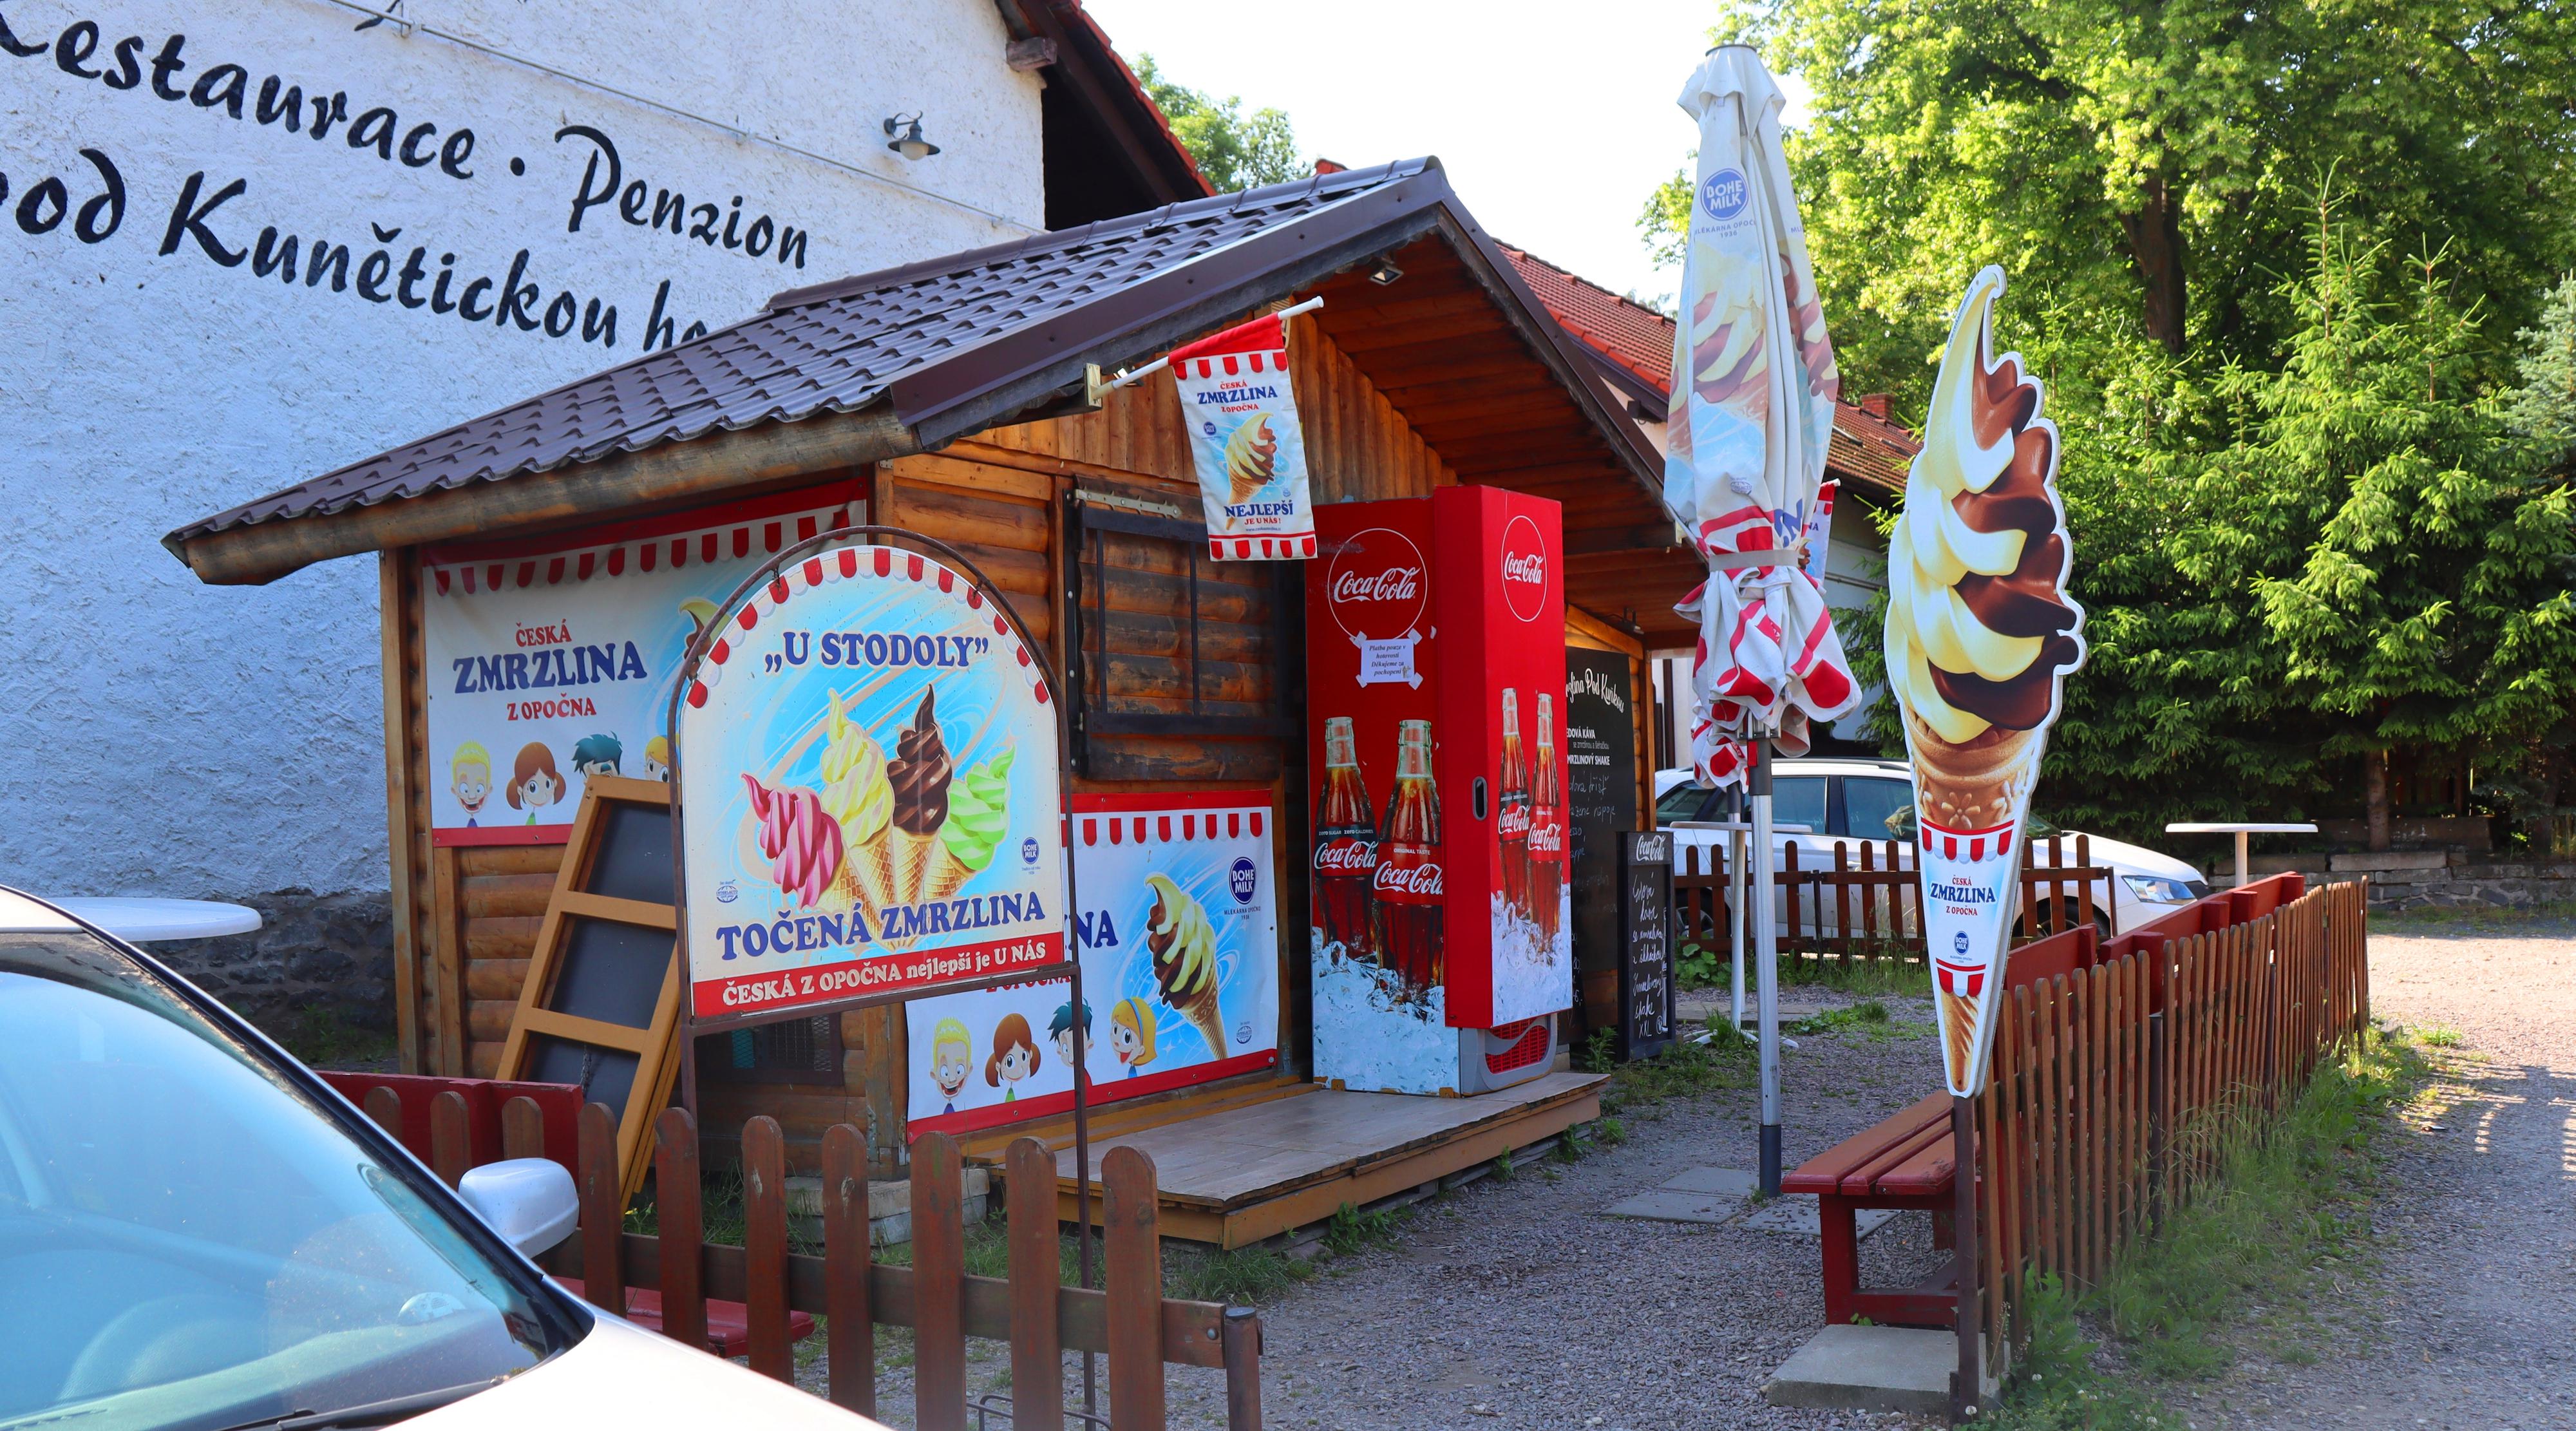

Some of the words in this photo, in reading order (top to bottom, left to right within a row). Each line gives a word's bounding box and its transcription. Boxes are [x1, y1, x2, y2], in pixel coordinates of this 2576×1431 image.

[555, 126, 807, 269] Penzion
[1706, 180, 1743, 198] BOHE
[1710, 193, 1741, 211] MILK
[0, 148, 126, 243] od
[158, 171, 616, 348] Kunětickou
[1197, 385, 1278, 405] ZMRZLINA
[1220, 379, 1247, 390] ČESKÁ
[1224, 500, 1294, 517] NEJLEPŠÍ
[1504, 551, 1544, 585] Coca-Cola
[1333, 567, 1421, 603] Coca-Cola
[516, 618, 572, 647] ČESKÁ
[453, 641, 648, 694] ZMRZLINA
[1585, 668, 1600, 695] Pod
[507, 703, 519, 721] Z
[522, 692, 596, 719] OPOČNA
[1582, 726, 1596, 739] KÁVA
[1595, 755, 1610, 766] SHAKE
[1499, 804, 1531, 835] Coca-Cola
[1528, 822, 1561, 851] Coca-Cola
[1636, 835, 1666, 862] Coca-Cola
[1025, 850, 1037, 858] MILK
[1314, 840, 1379, 869] Coca-Cola
[1232, 869, 1255, 882] BOHE
[1235, 881, 1253, 894] MILK
[1952, 875, 1973, 886] ČESKÁ
[1930, 882, 1996, 903] ZMRZLINA
[1951, 905, 1978, 916] OPOČNA
[716, 907, 871, 960] TOČENÁ
[880, 891, 1046, 940] ZMRZLINA
[722, 977, 797, 1006] ČESKÁ
[800, 976, 815, 995] Z
[819, 961, 902, 992] OPOČNA
[906, 951, 972, 980] nejlepší
[974, 954, 990, 973] je
[994, 947, 1009, 965] U
[1010, 941, 1046, 962] NÁS
